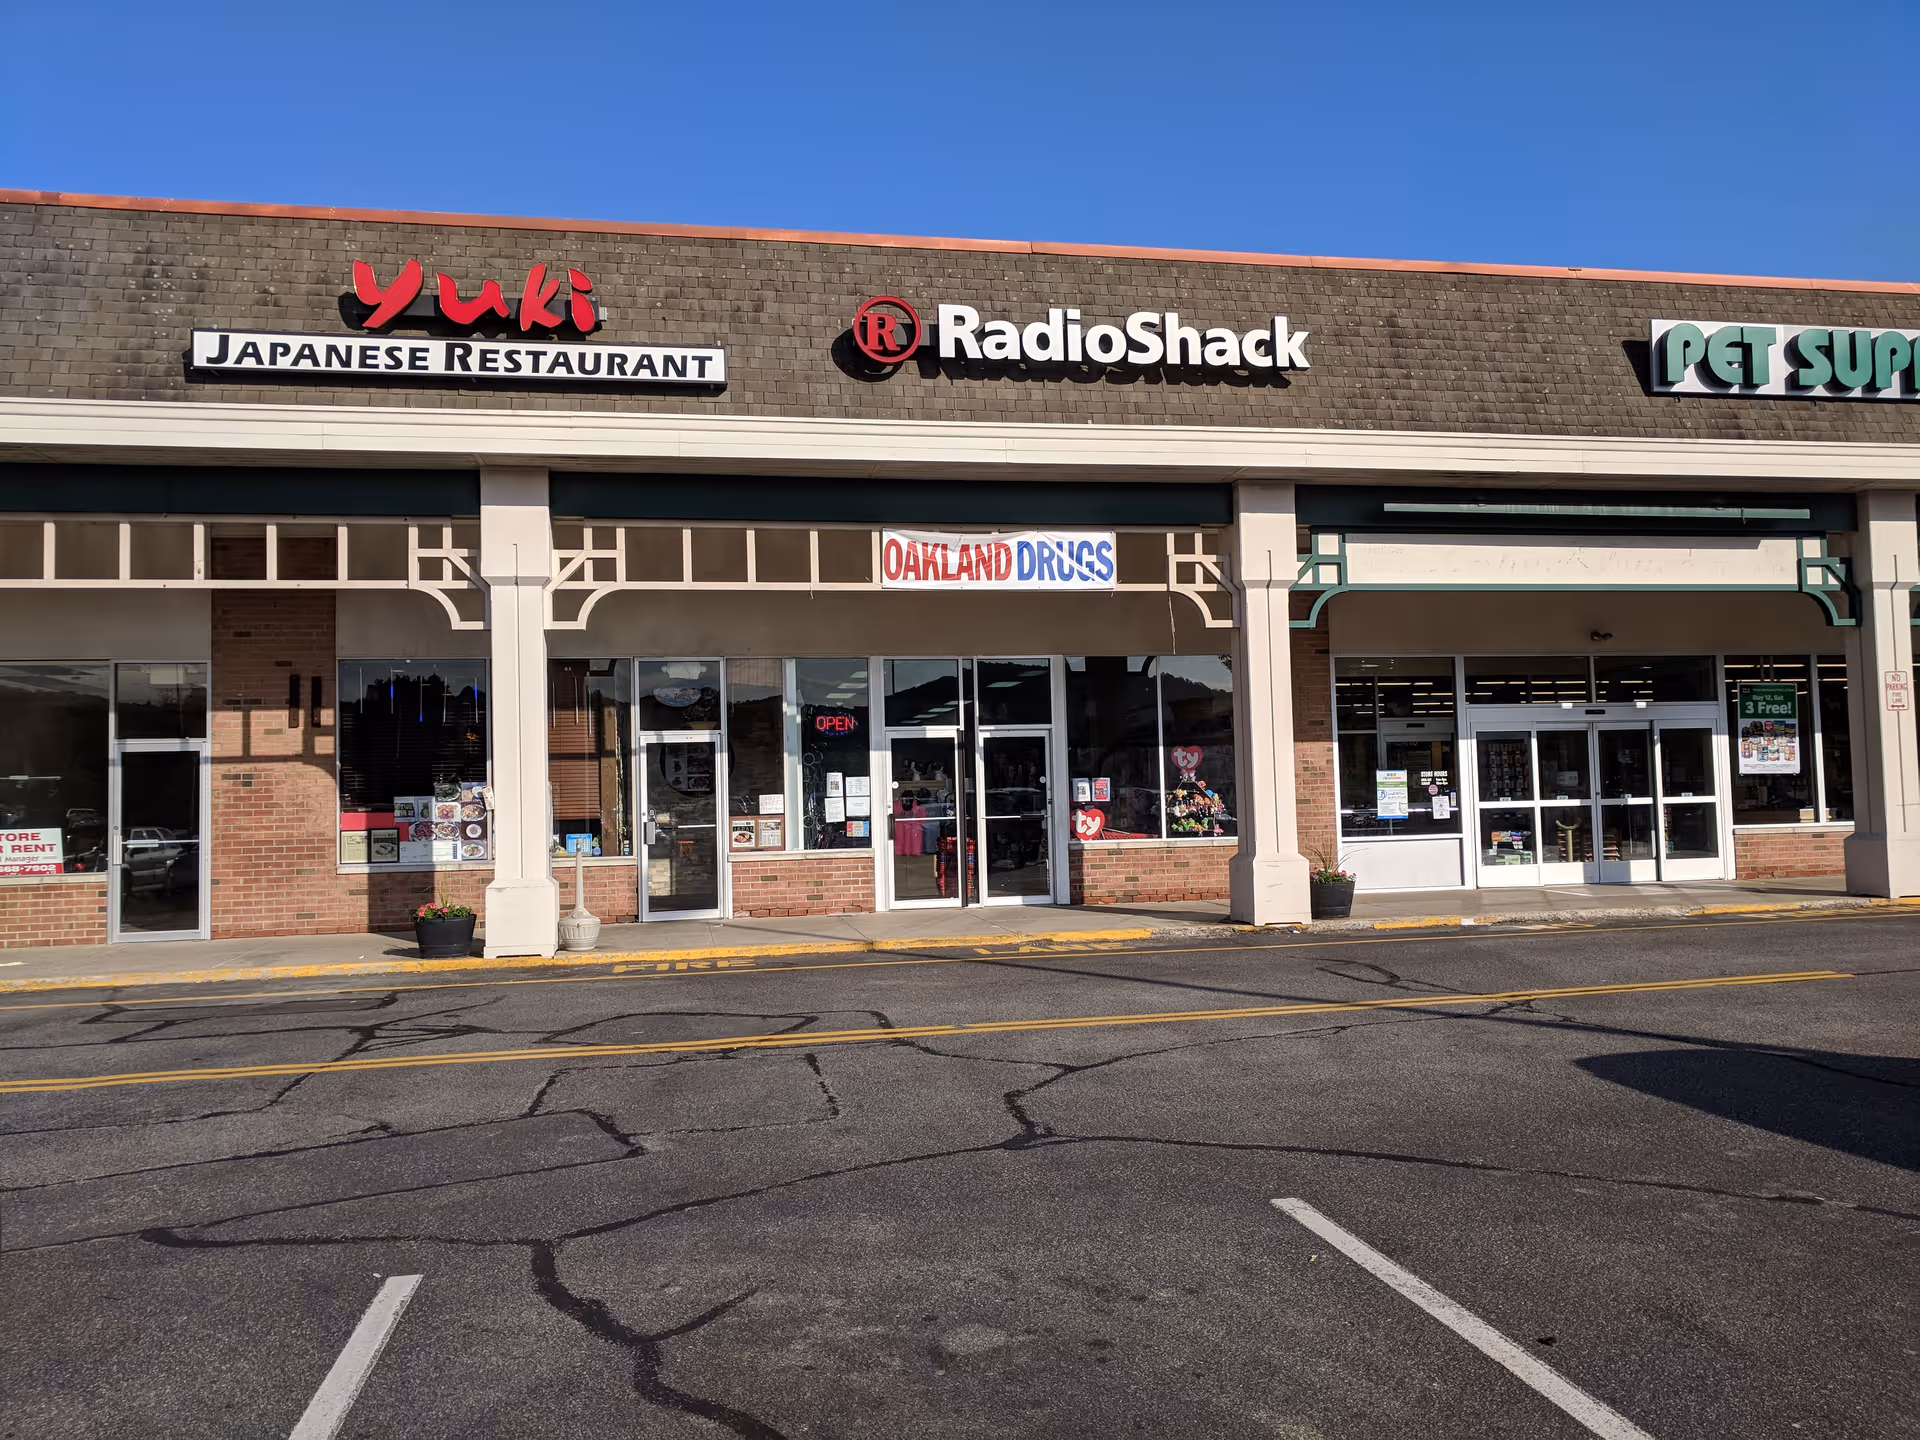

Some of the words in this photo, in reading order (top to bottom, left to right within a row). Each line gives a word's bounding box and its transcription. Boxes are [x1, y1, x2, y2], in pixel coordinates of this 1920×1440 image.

[938, 303, 1311, 370] RadioShack
[205, 333, 430, 371] JAPANESE
[443, 340, 715, 380] RESTAURANT
[1666, 322, 1777, 385] PET
[1797, 328, 1920, 389] SUP
[883, 538, 1013, 583] OAKLAND
[1017, 539, 1114, 583] DRUGS
[1892, 673, 1901, 682] NO
[1745, 701, 1755, 714] 3
[1757, 701, 1793, 714] Free!
[816, 715, 855, 731] OPEN
[1173, 747, 1199, 768] ty
[1071, 809, 1101, 835] ty
[11, 843, 57, 853] RENT
